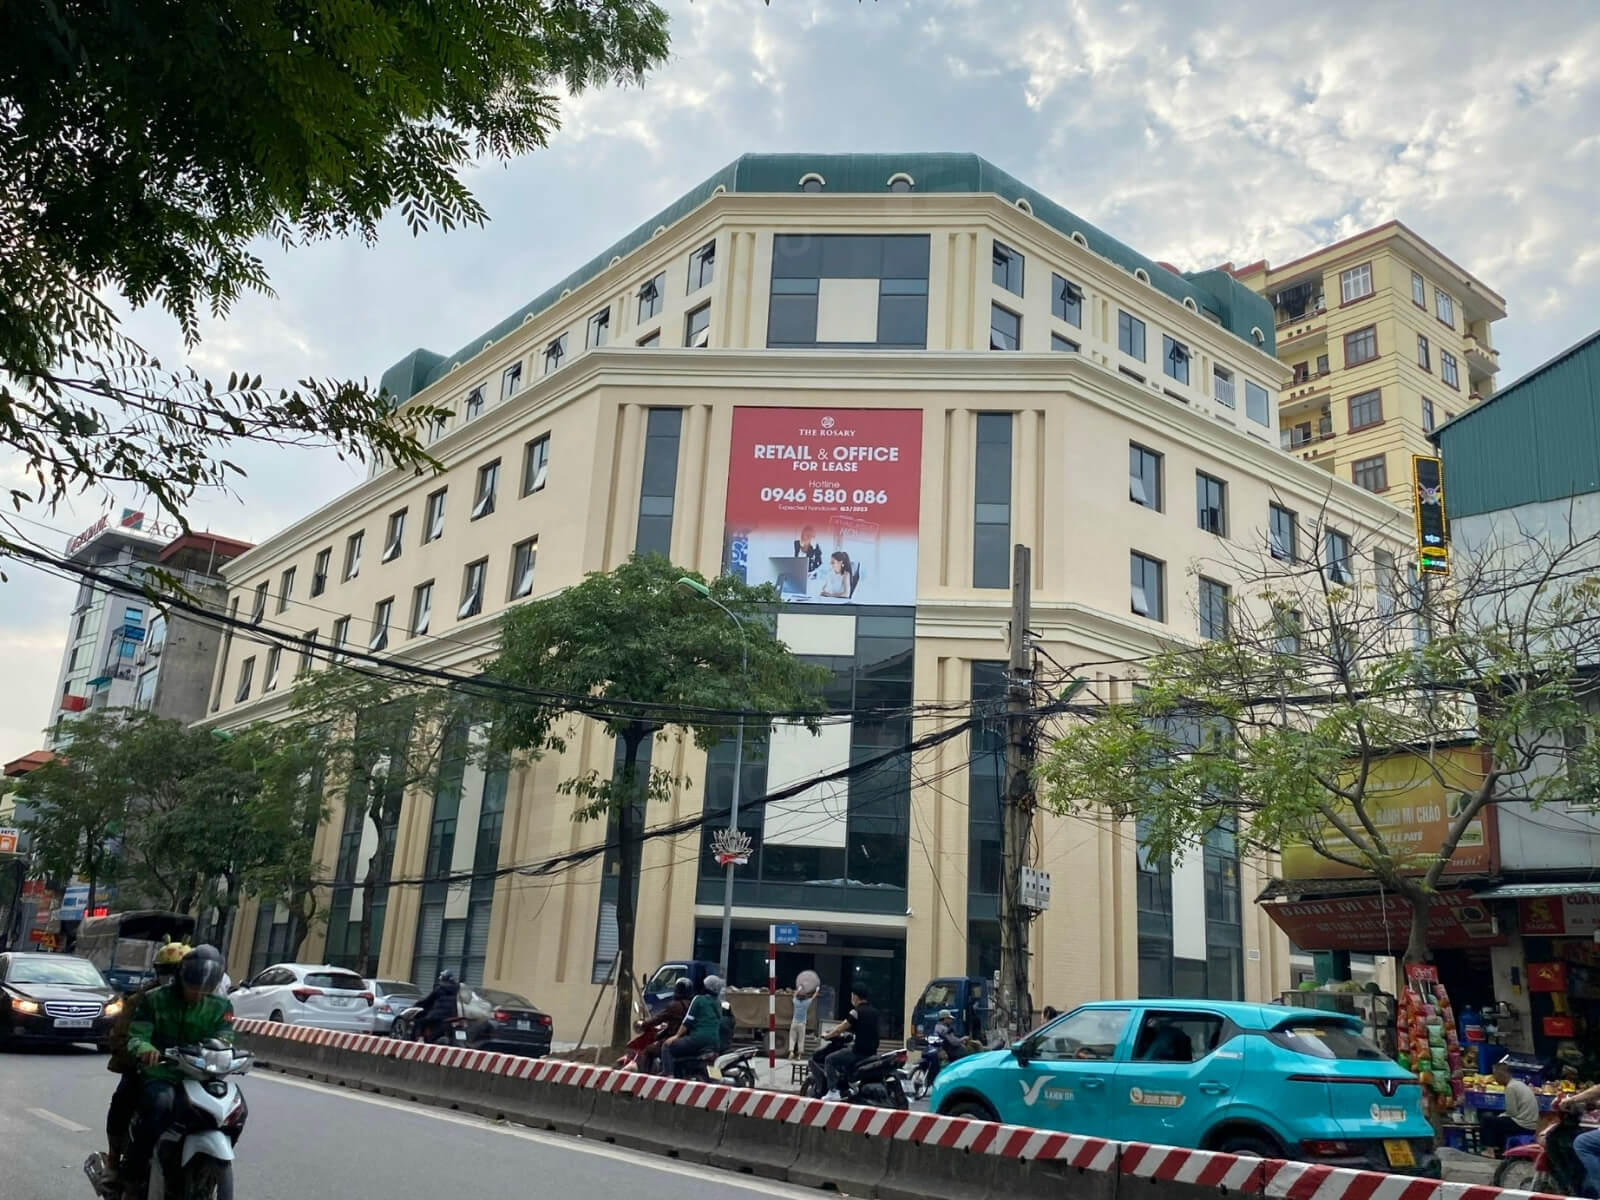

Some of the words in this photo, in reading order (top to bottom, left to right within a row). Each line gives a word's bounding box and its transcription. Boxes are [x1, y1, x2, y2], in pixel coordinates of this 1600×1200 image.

[820, 429, 856, 437] ROSARY
[754, 444, 812, 460] RETAIL
[817, 448, 829, 461] &
[833, 446, 899, 461] OFFICE
[793, 461, 818, 471] FOR
[822, 462, 858, 472] LEASE
[808, 479, 840, 489] Hotline
[760, 487, 807, 503] 0946
[812, 489, 847, 503] 580
[852, 490, 888, 504] 086
